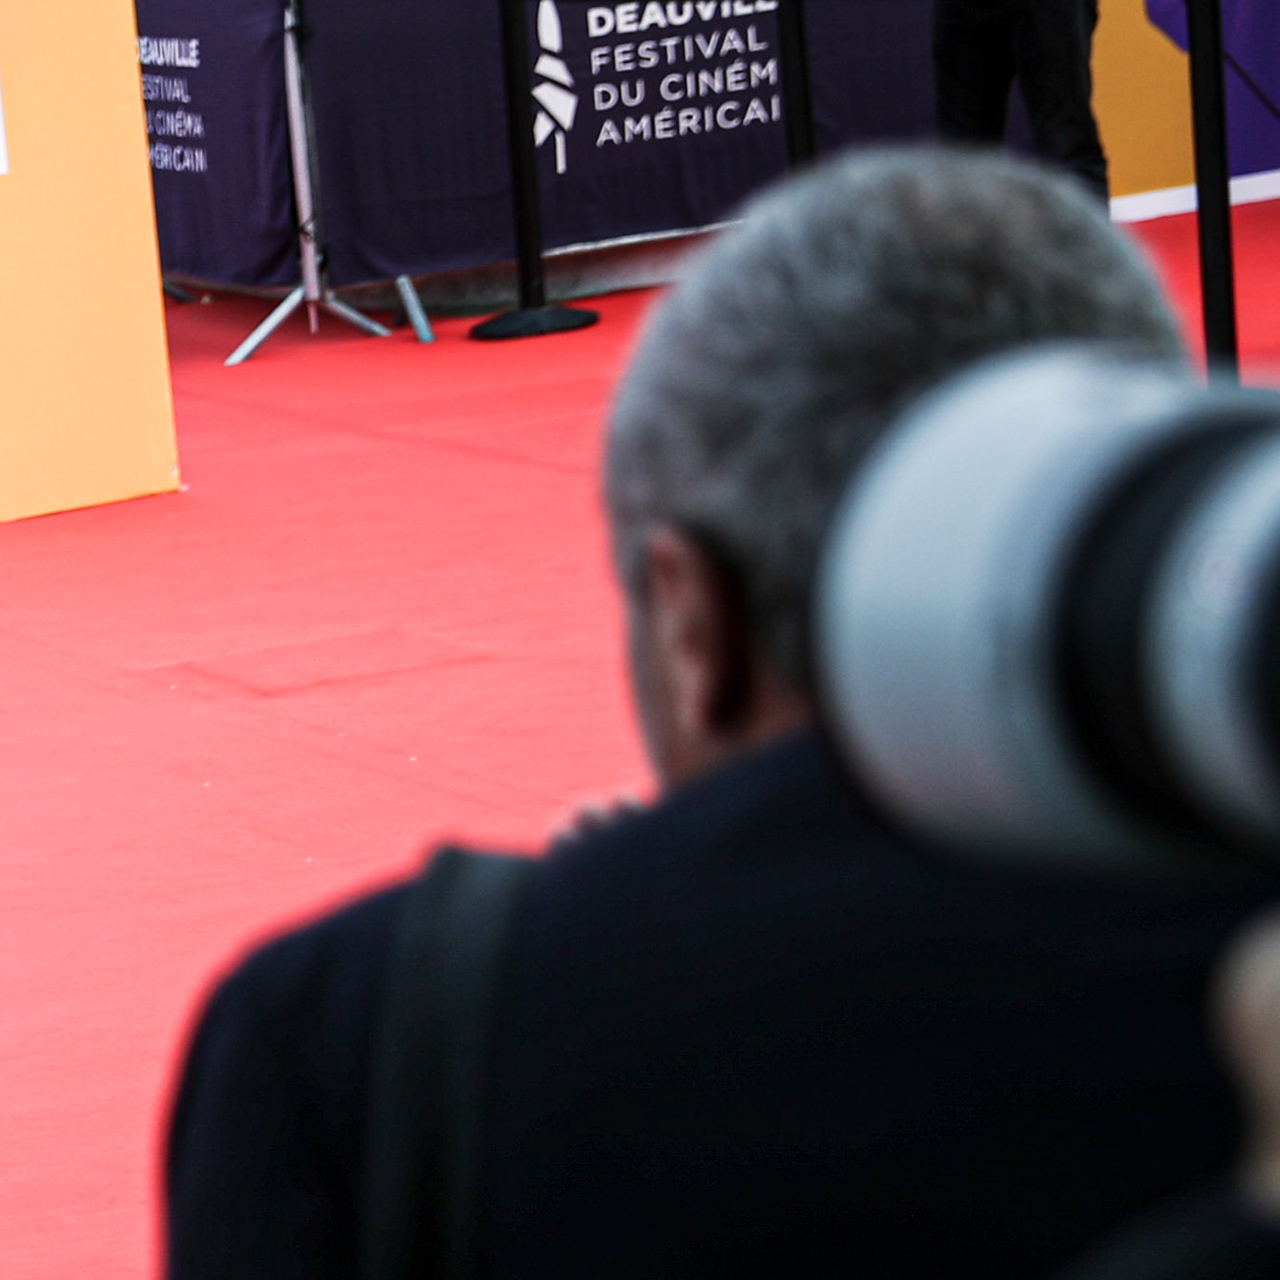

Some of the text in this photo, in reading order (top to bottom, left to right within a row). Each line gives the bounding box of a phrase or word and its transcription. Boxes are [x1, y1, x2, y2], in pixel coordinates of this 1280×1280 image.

[587, 0, 779, 38] DEAUVIL
[138, 36, 200, 68] EAUVILLE
[590, 24, 769, 75] FESTIVAL
[593, 57, 778, 111] DU CINÉM
[595, 93, 781, 148] AMÉRICAI
